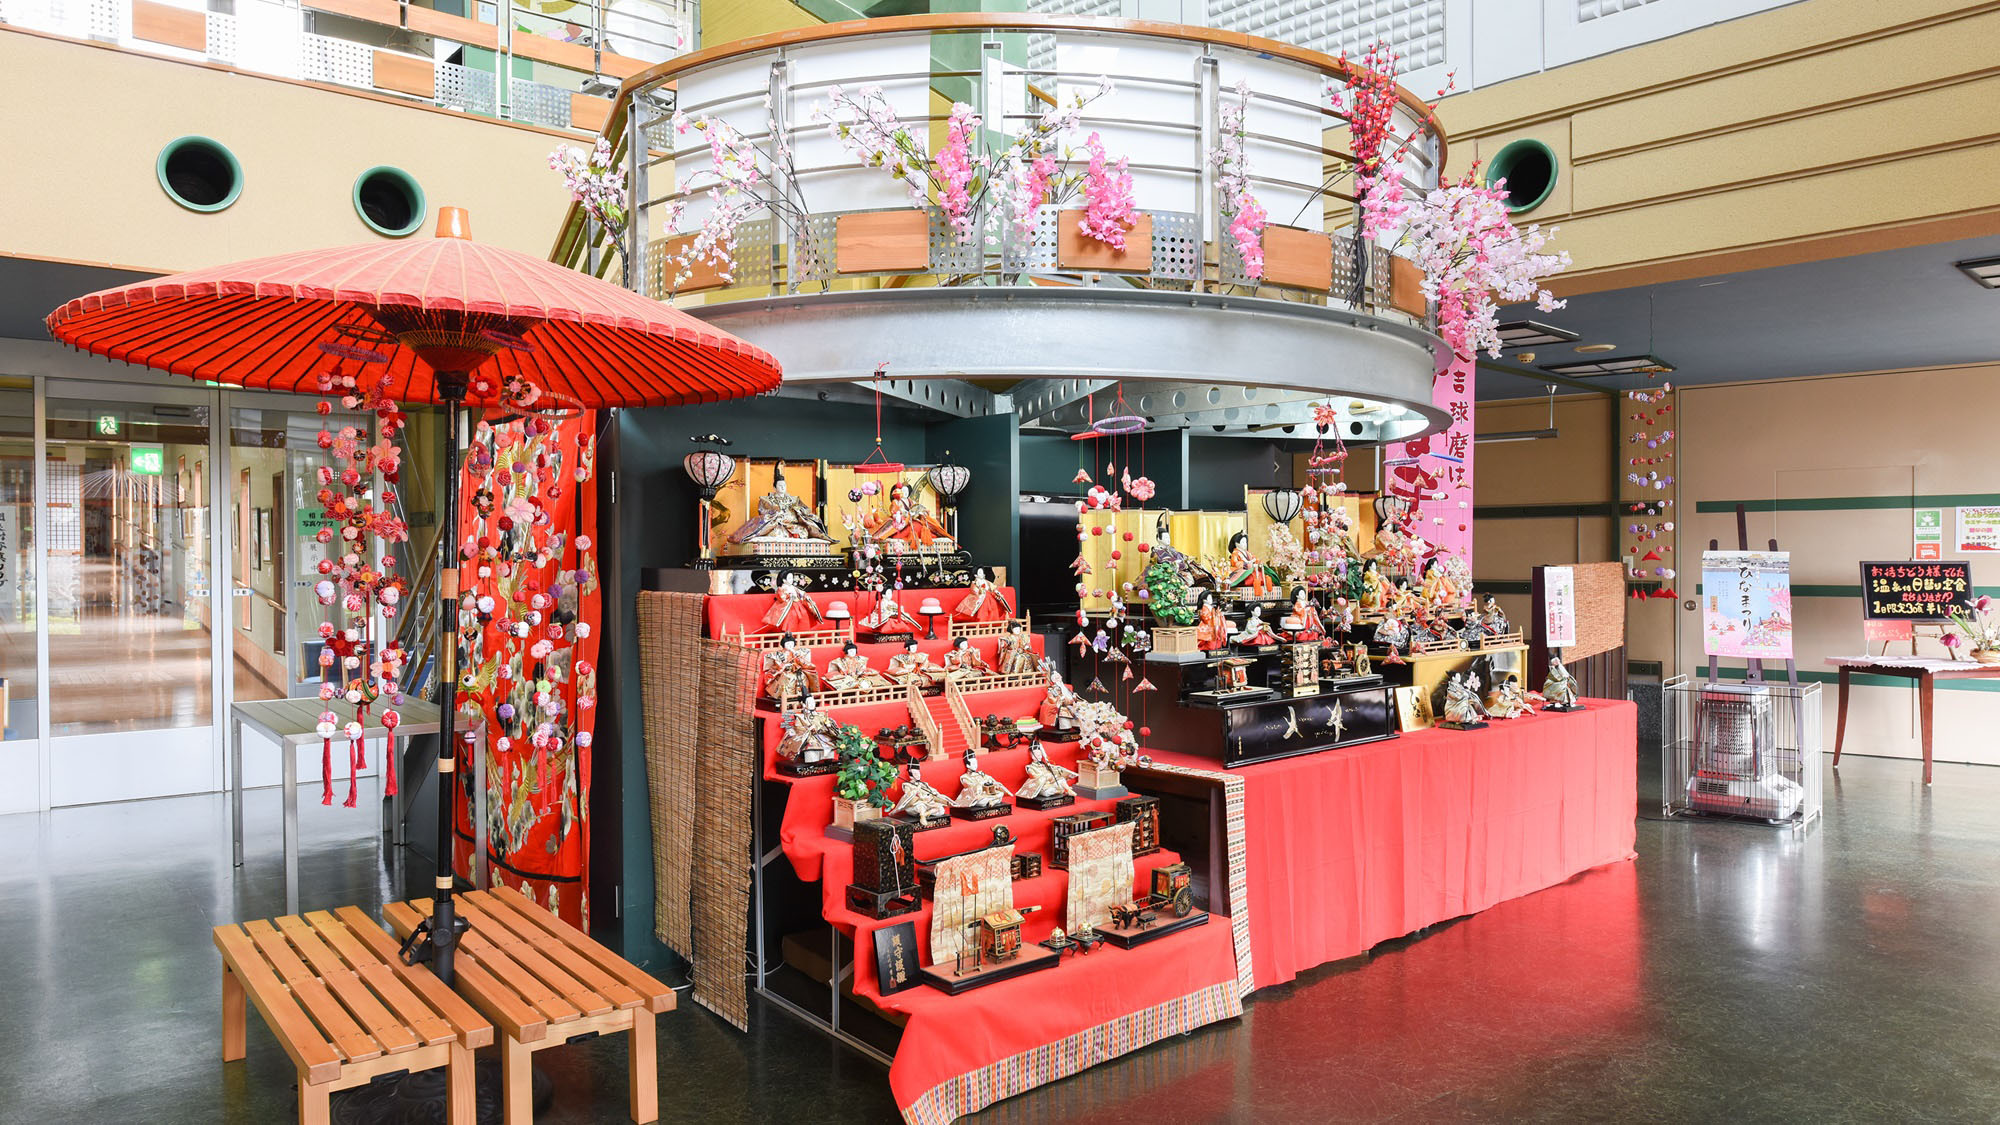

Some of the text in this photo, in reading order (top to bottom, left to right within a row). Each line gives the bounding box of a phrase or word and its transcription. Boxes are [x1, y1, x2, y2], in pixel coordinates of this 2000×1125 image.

[1739, 566, 1753, 632] ひなまつり
